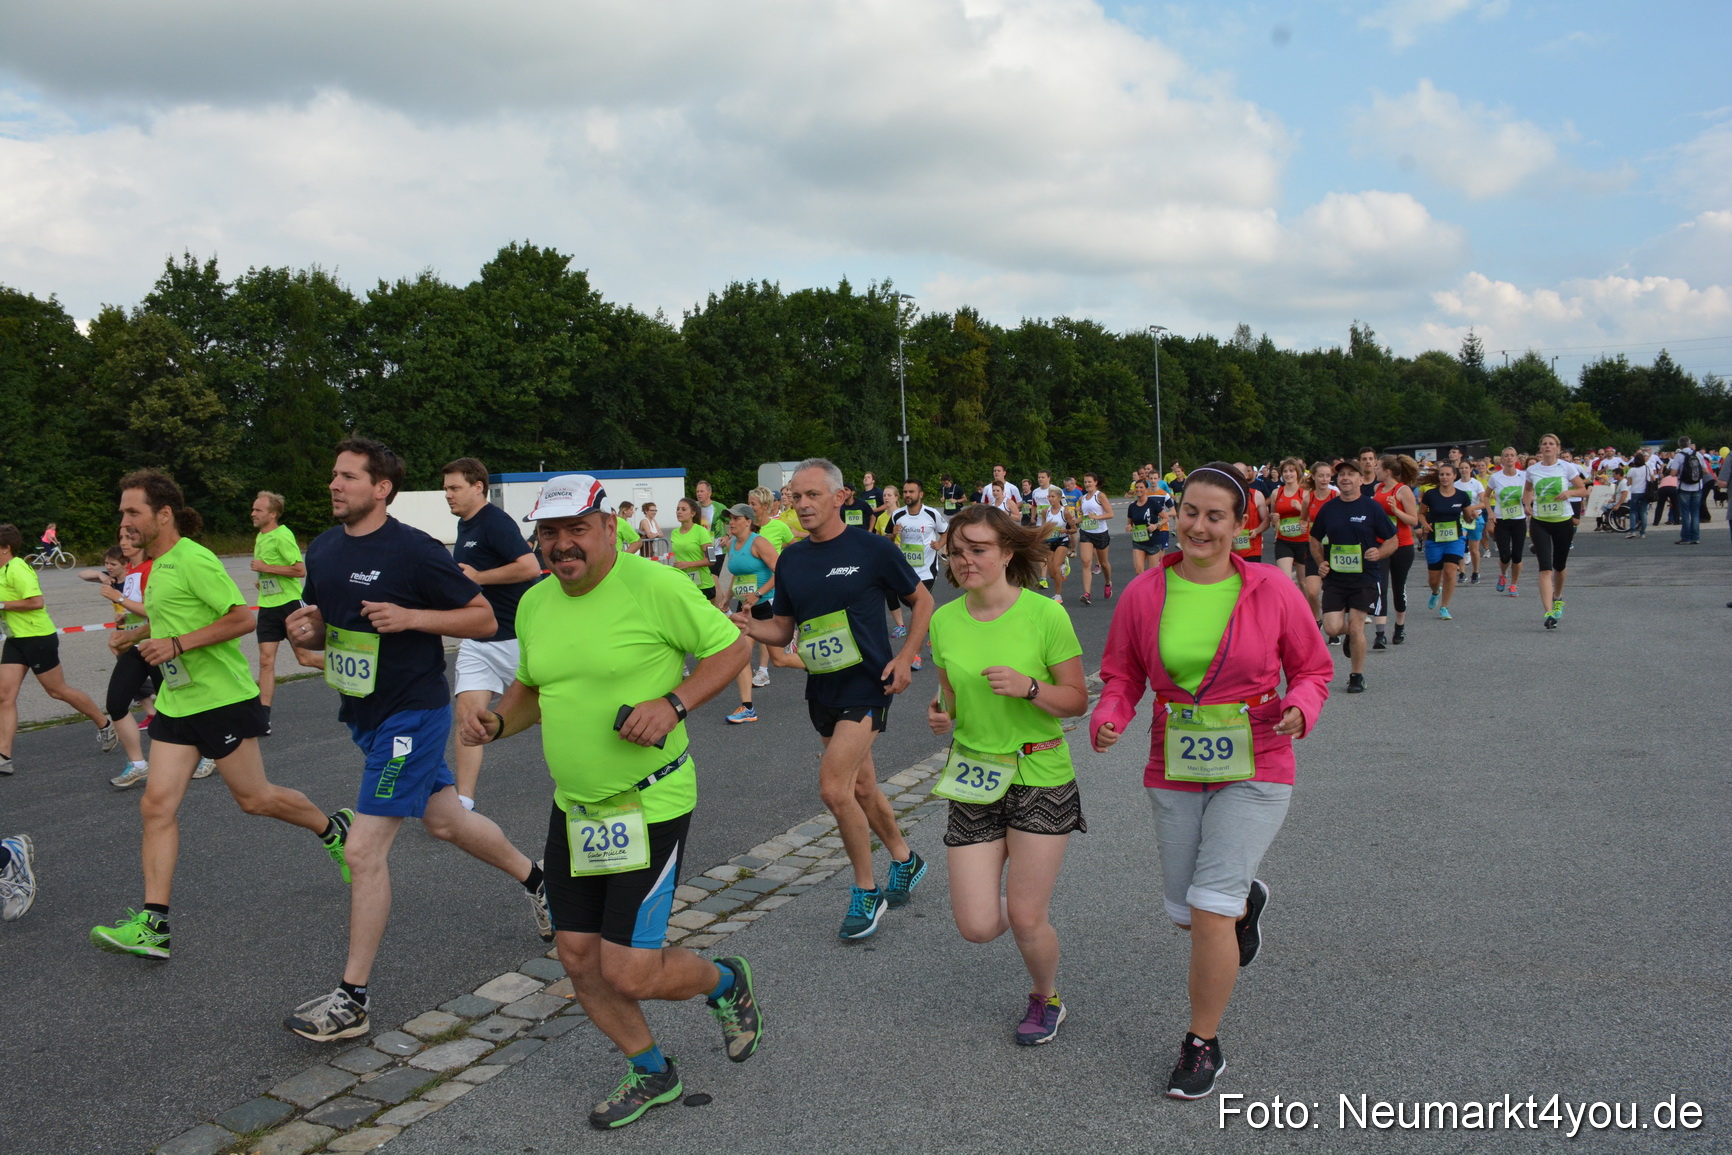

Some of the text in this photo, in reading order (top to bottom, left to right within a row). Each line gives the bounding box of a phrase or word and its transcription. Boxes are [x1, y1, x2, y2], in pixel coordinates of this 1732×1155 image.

[1506, 506, 1518, 514] 107
[1542, 503, 1558, 512] 112
[1281, 524, 1301, 533] 1385
[1439, 529, 1454, 537] 706
[1333, 555, 1360, 566] 1304
[734, 585, 755, 595] 1295
[806, 636, 844, 661] 753
[328, 651, 371, 680] 1303
[1180, 736, 1234, 762] 239
[955, 762, 1001, 791] 235
[580, 822, 630, 852] 238
